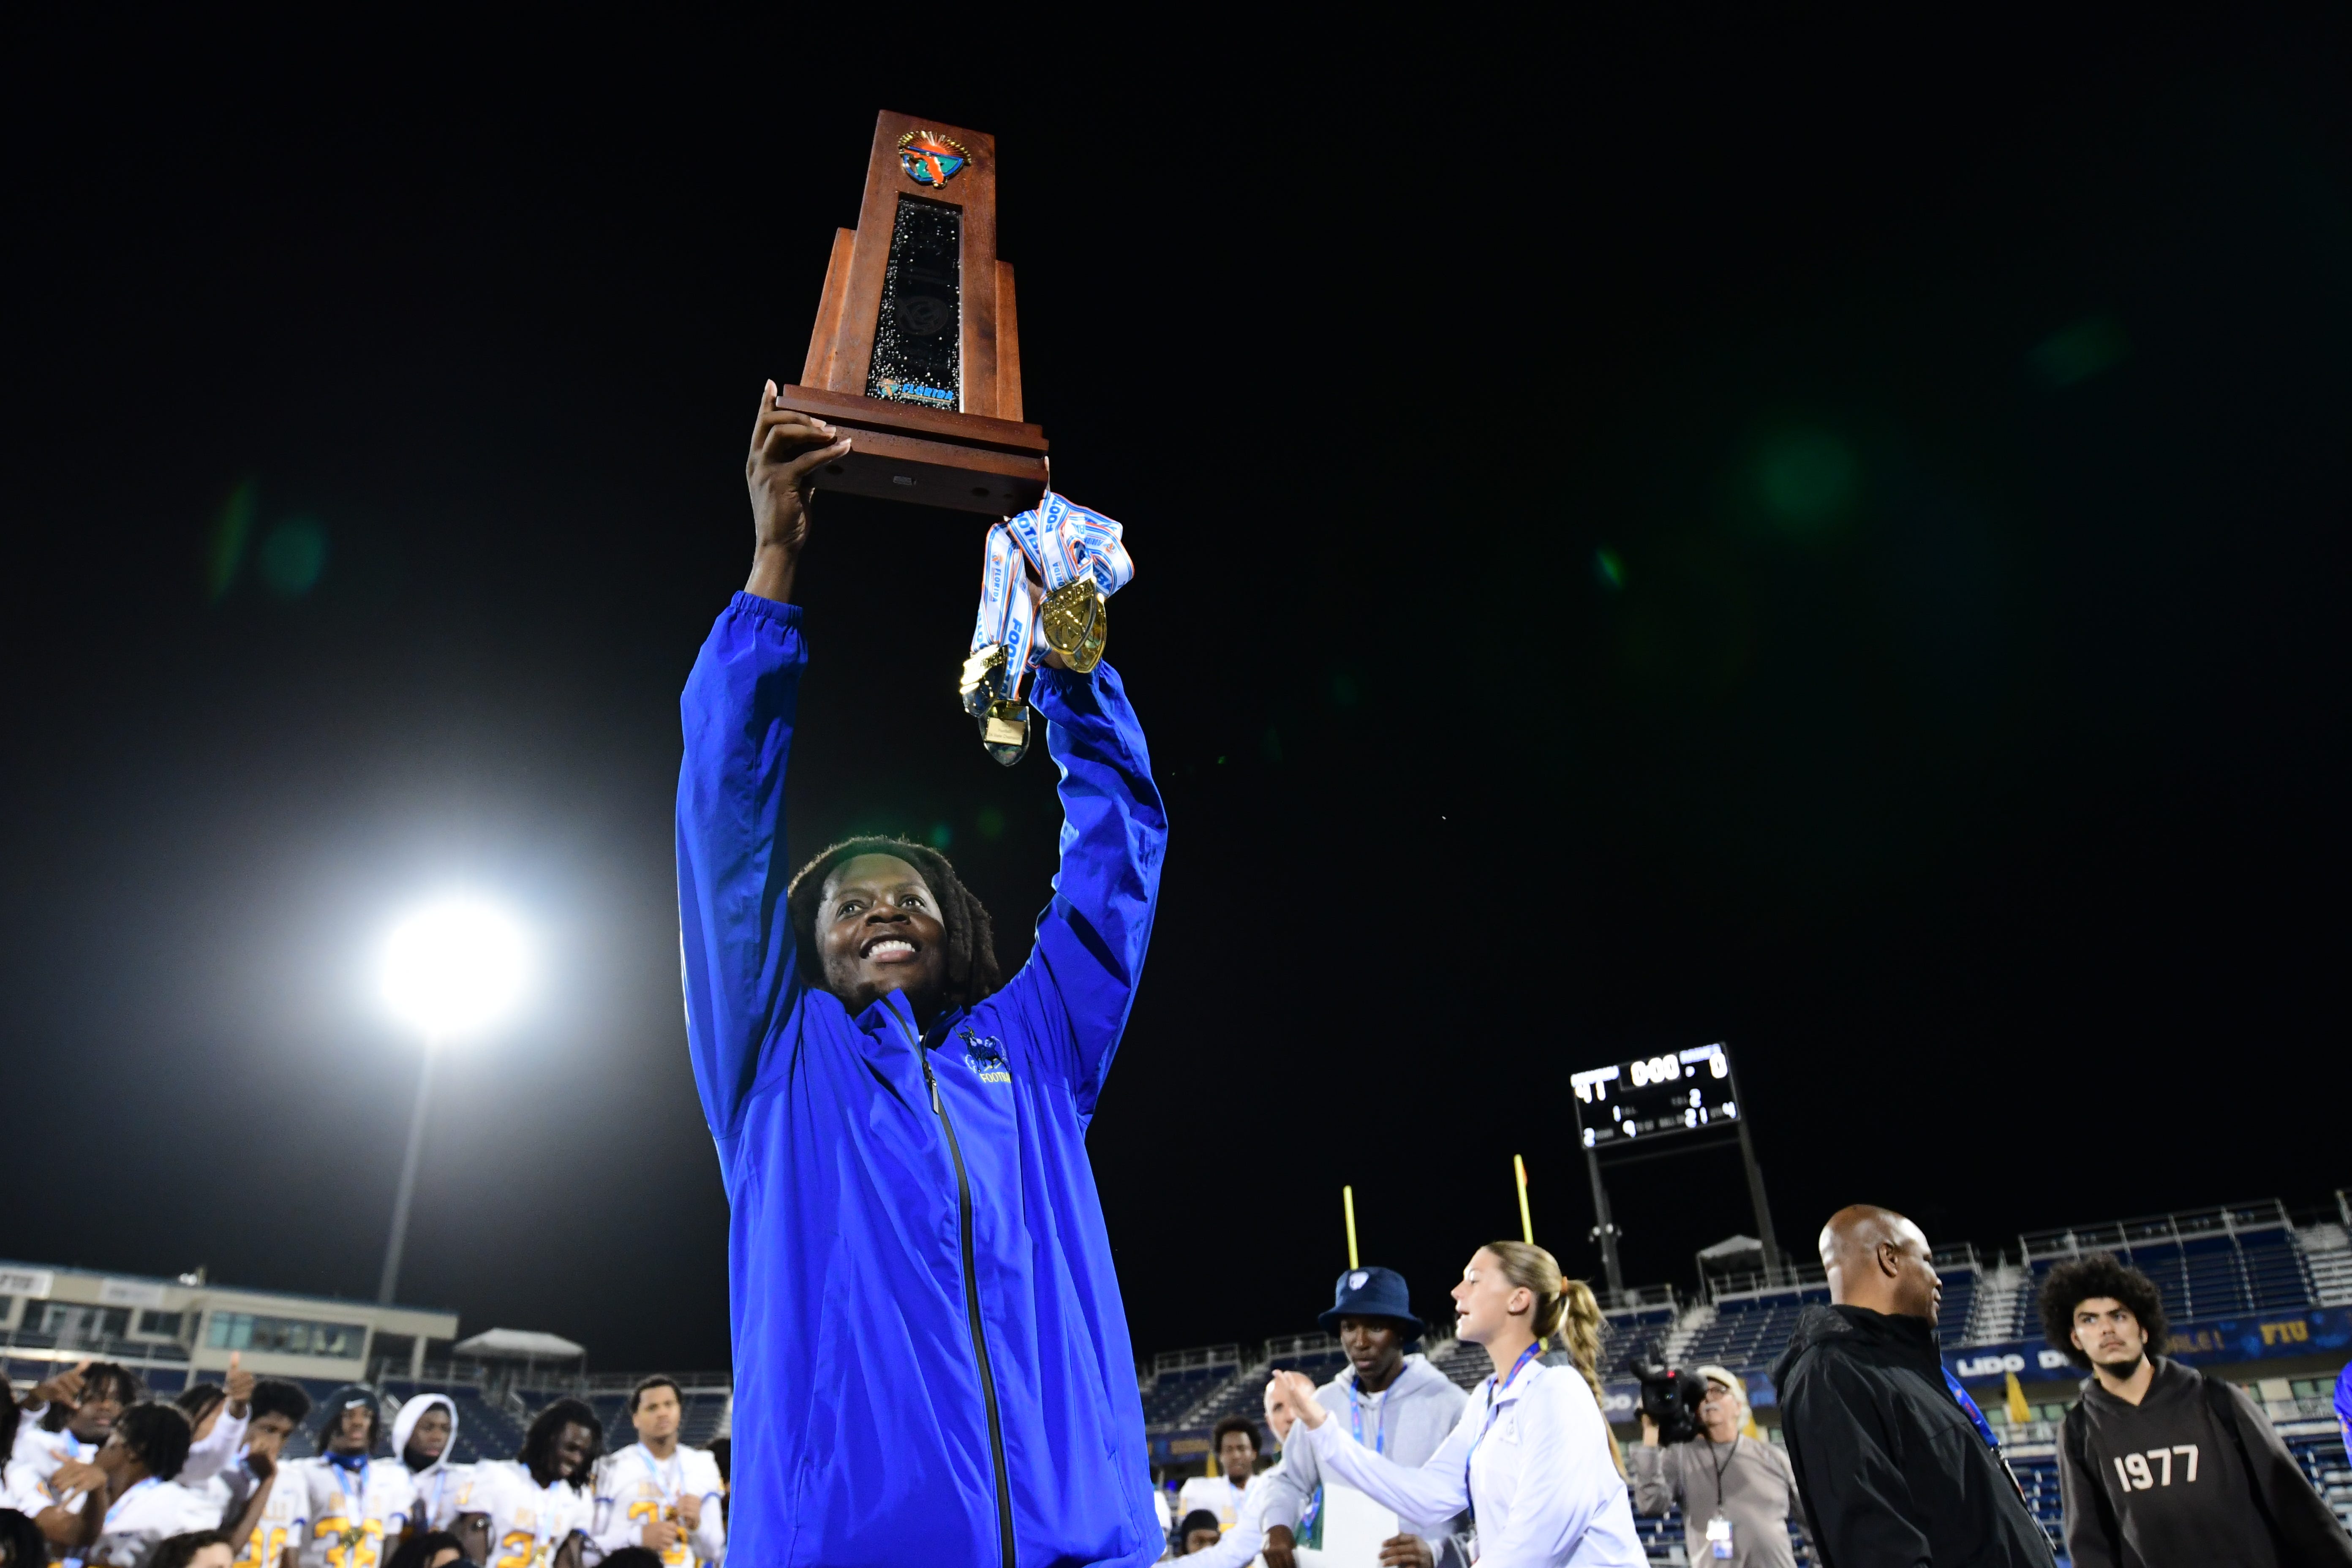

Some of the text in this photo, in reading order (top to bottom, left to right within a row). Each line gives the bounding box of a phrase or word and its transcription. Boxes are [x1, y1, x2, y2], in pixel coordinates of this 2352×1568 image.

[902, 383, 953, 400] FLORIDA
[992, 568, 1001, 602] FLORIDA
[1052, 561, 1063, 587] ORIDA
[980, 1072, 1011, 1083] FOOTBA
[1956, 1353, 2025, 1377] LIDO
[2113, 1444, 2199, 1493] 1977
